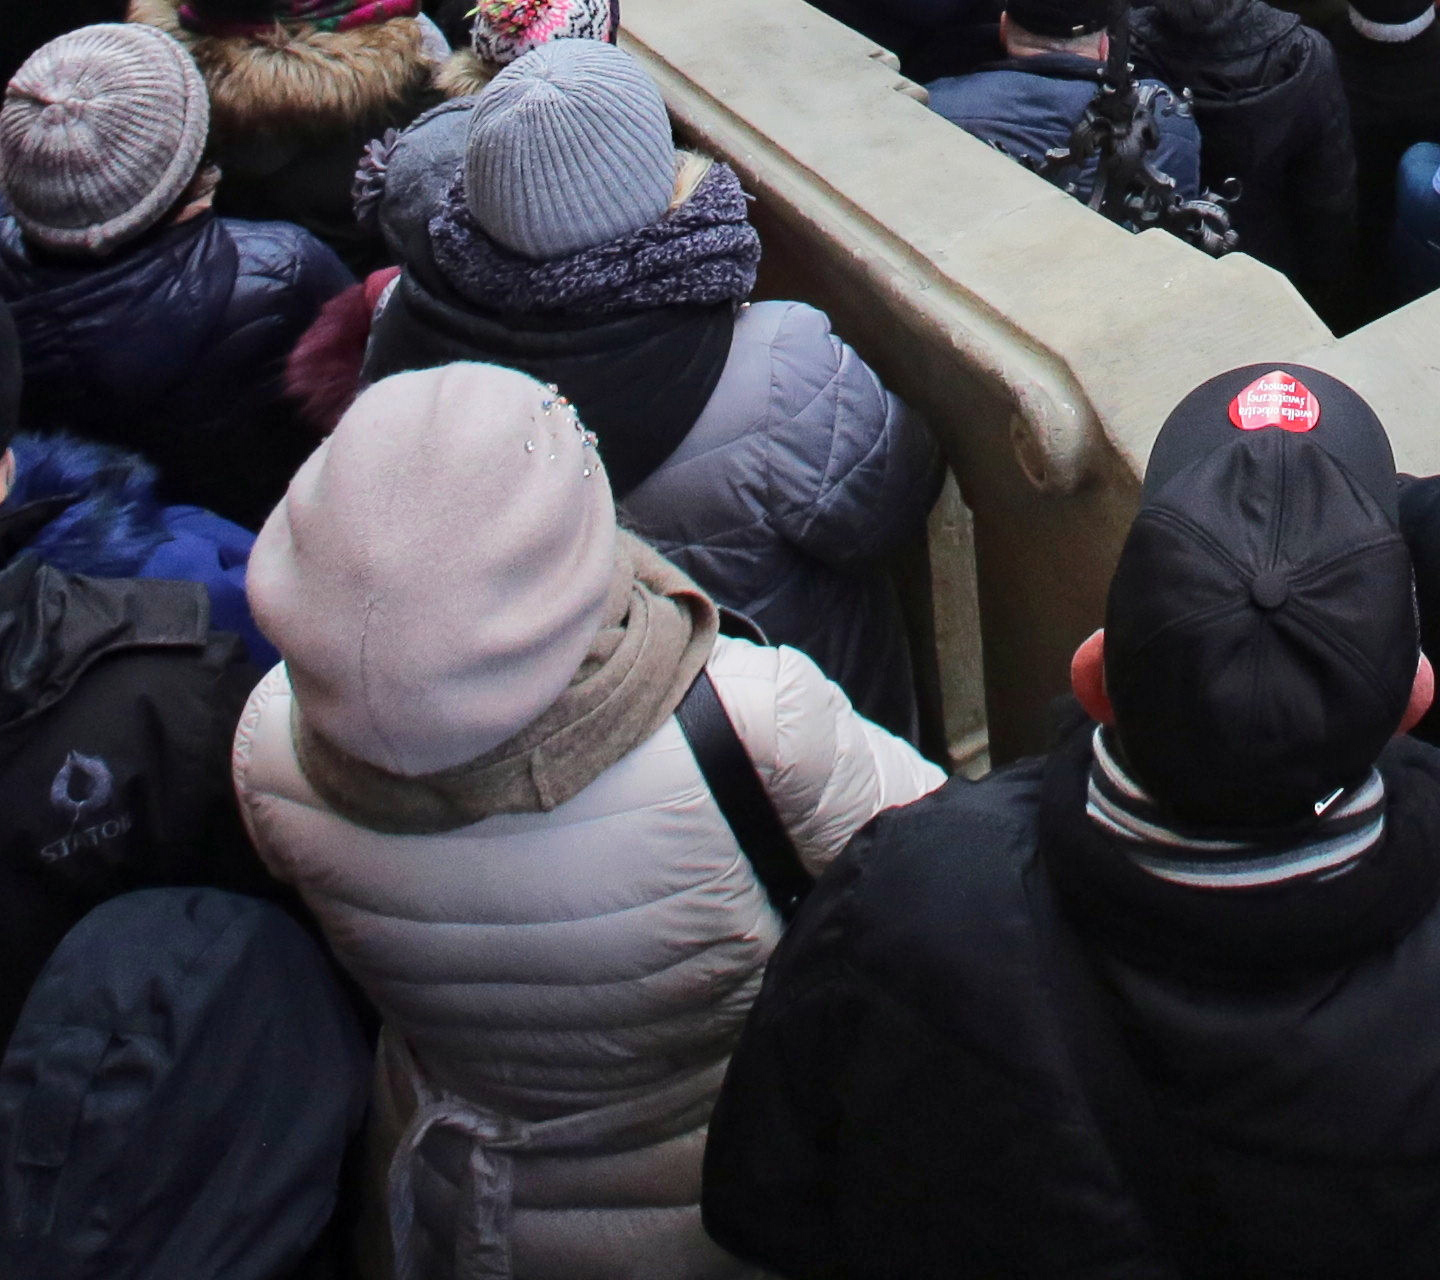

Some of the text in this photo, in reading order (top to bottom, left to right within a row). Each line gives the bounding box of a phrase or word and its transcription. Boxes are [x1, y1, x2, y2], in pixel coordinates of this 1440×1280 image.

[1257, 380, 1296, 392] pomocy
[1239, 407, 1312, 421] wielka orkiestra
